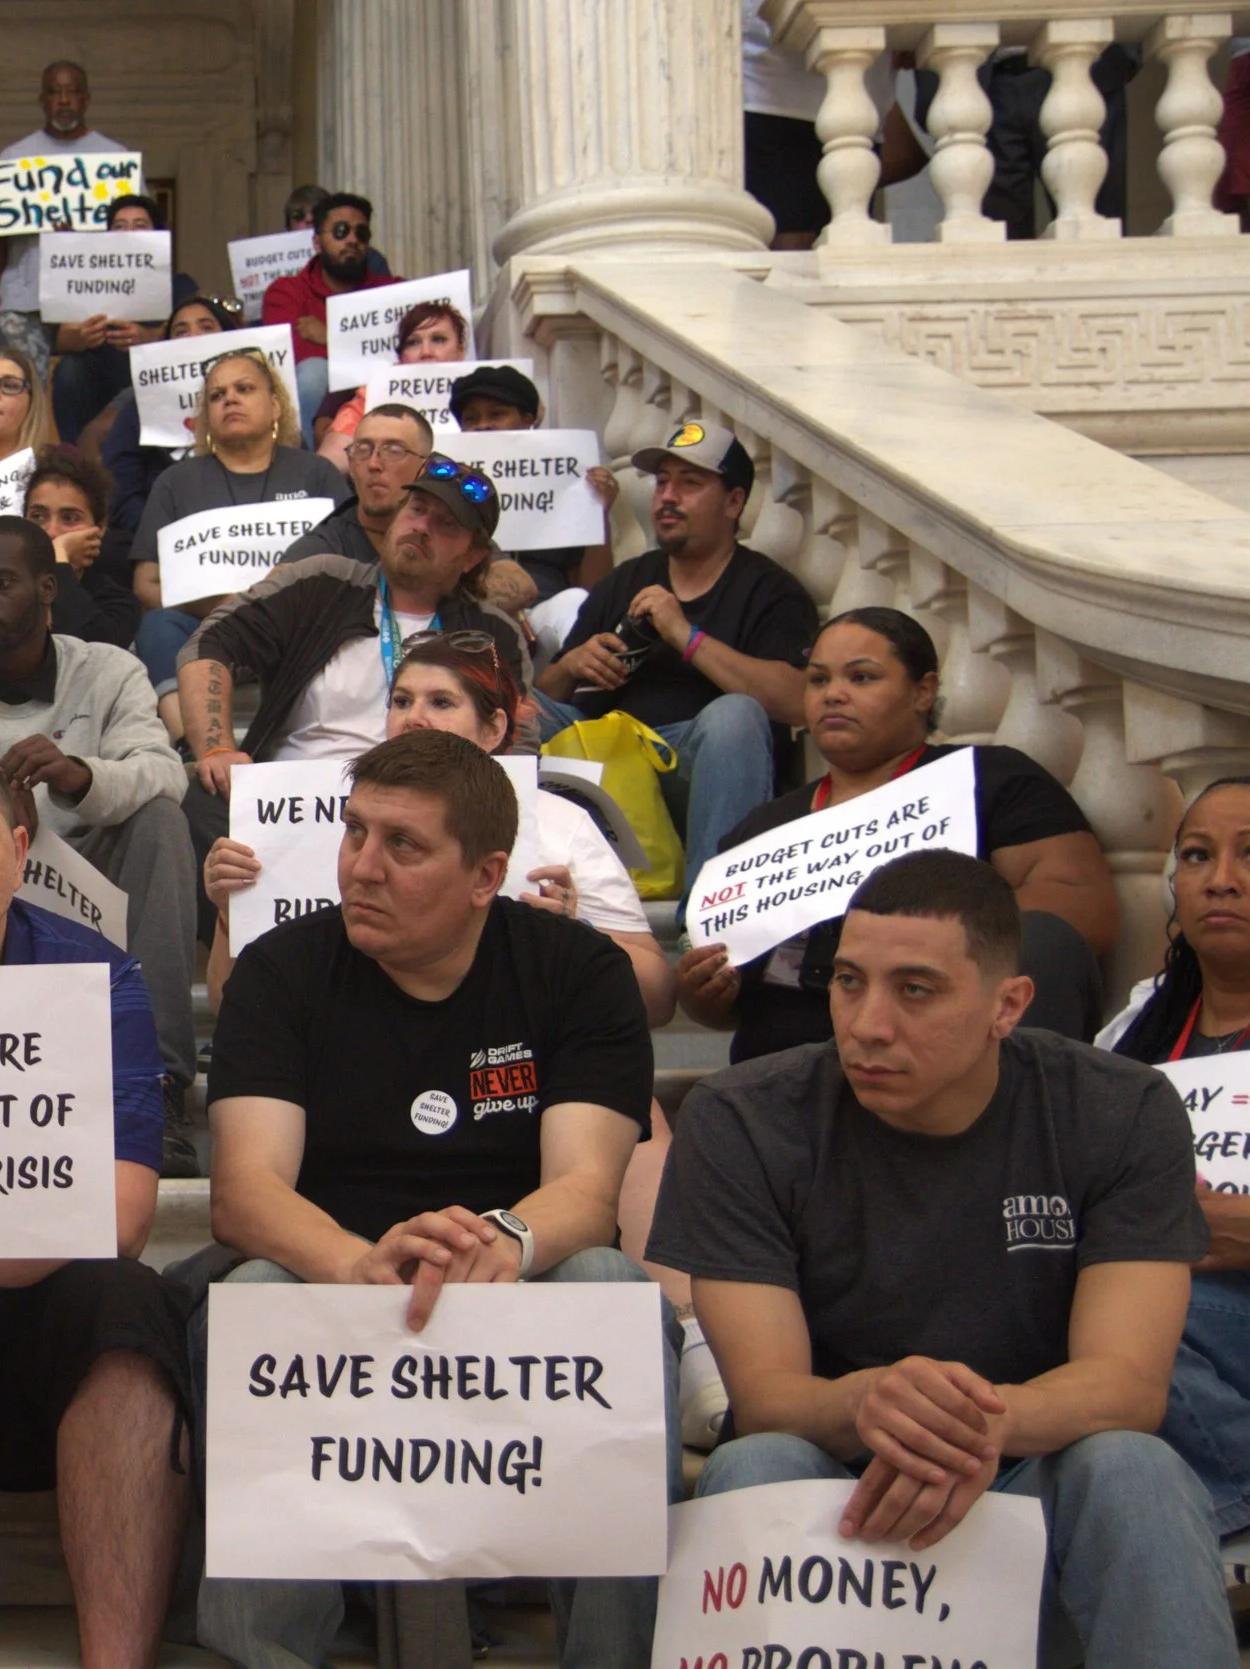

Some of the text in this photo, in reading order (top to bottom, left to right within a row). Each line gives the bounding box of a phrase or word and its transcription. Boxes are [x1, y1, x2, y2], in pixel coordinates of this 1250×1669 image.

[96, 160, 138, 180] our
[50, 252, 156, 270] SAVE SHELTER
[67, 278, 136, 296] FUNDING!
[340, 311, 380, 332] SAVE
[139, 361, 206, 387] SHELTE
[492, 457, 581, 478] SHELTER
[0, 496, 13, 510] &
[501, 490, 554, 513] DING!
[174, 526, 221, 553] SAVE
[256, 796, 305, 825] WE
[725, 796, 931, 878] BUDGET CUTS ARE
[699, 817, 951, 911] NOT THE WAY OUT OF
[23, 859, 104, 935] HELTER
[700, 870, 865, 937] THIS HOUSING
[487, 1049, 533, 1065] GAMES
[488, 1042, 523, 1056] DRIFT
[472, 1064, 535, 1097] NEVER
[30, 1093, 75, 1128] OF
[419, 1102, 451, 1117] SHELTER
[430, 1092, 448, 1104] SAVE
[473, 1095, 539, 1121] give up
[414, 1113, 449, 1129] FUNDING!
[1003, 1194, 1072, 1218] amo
[249, 1353, 612, 1409] SAVE SHELTER
[310, 1435, 543, 1494] FUNDING!
[702, 1554, 950, 1622] NO MONEY,
